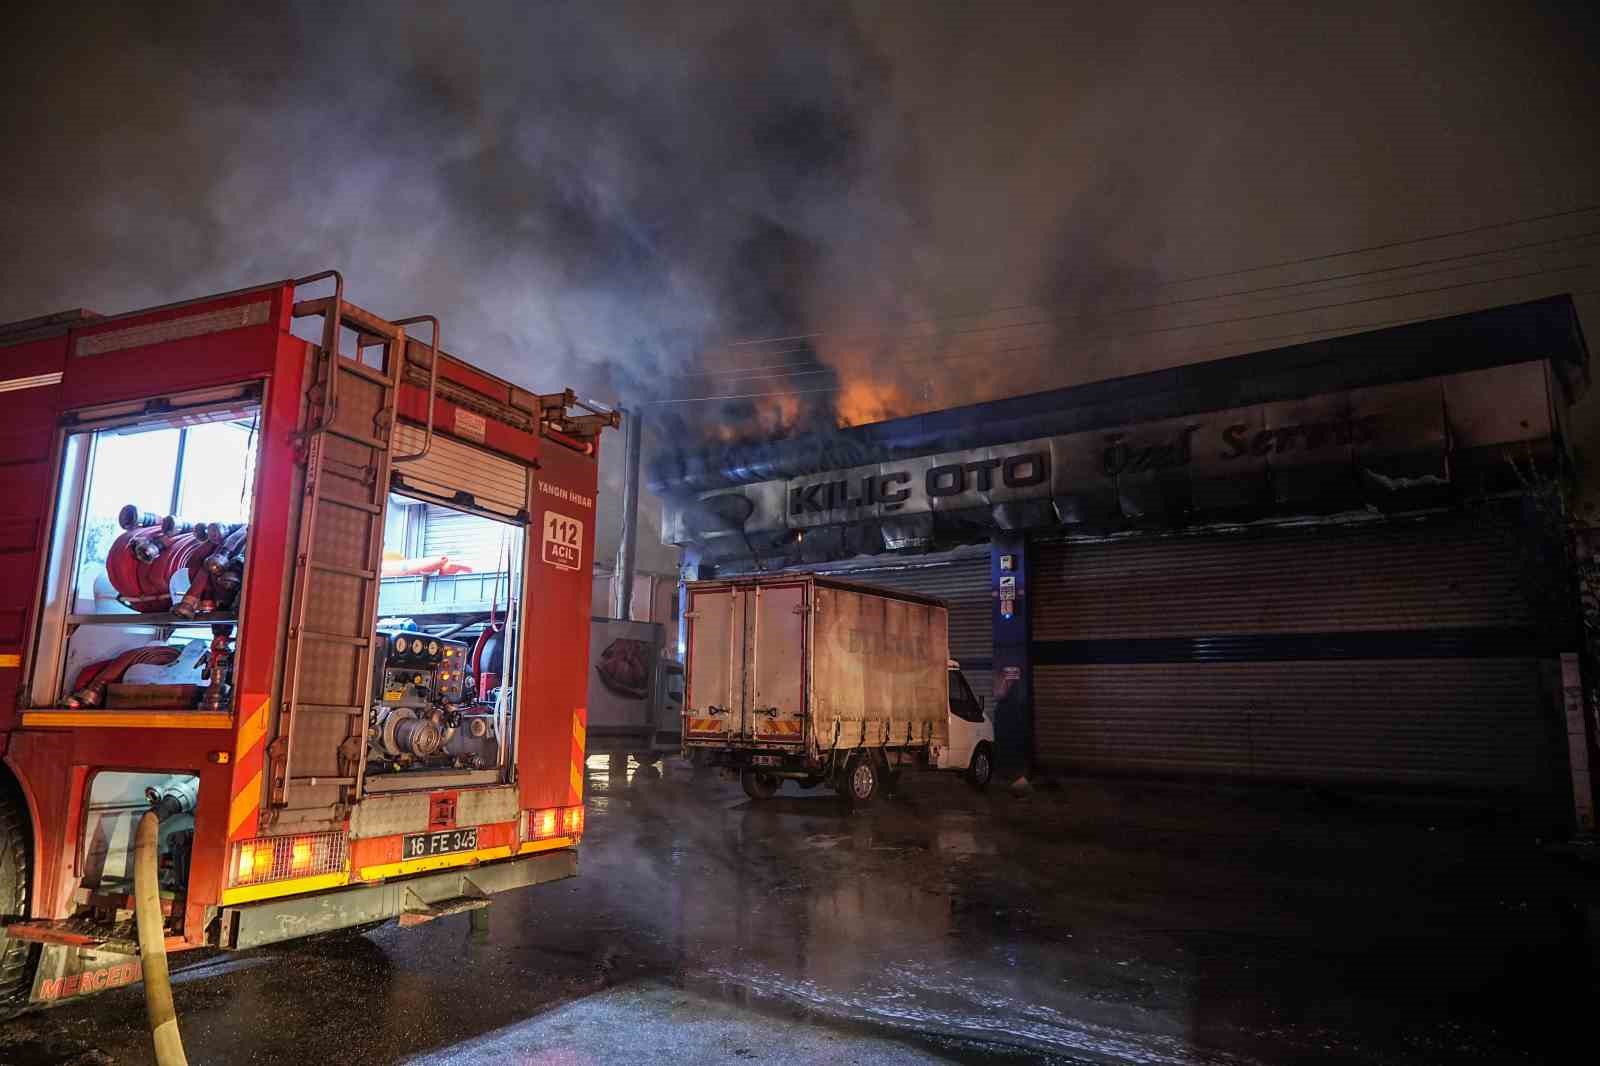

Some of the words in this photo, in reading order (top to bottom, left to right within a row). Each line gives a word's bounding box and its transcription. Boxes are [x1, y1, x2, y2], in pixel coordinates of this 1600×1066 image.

[926, 453, 1043, 497] OTO
[538, 480, 568, 500] YANGIN
[550, 518, 577, 546] 112
[411, 837, 425, 856] 16
[430, 834, 450, 853] FE
[454, 831, 476, 850] 345
